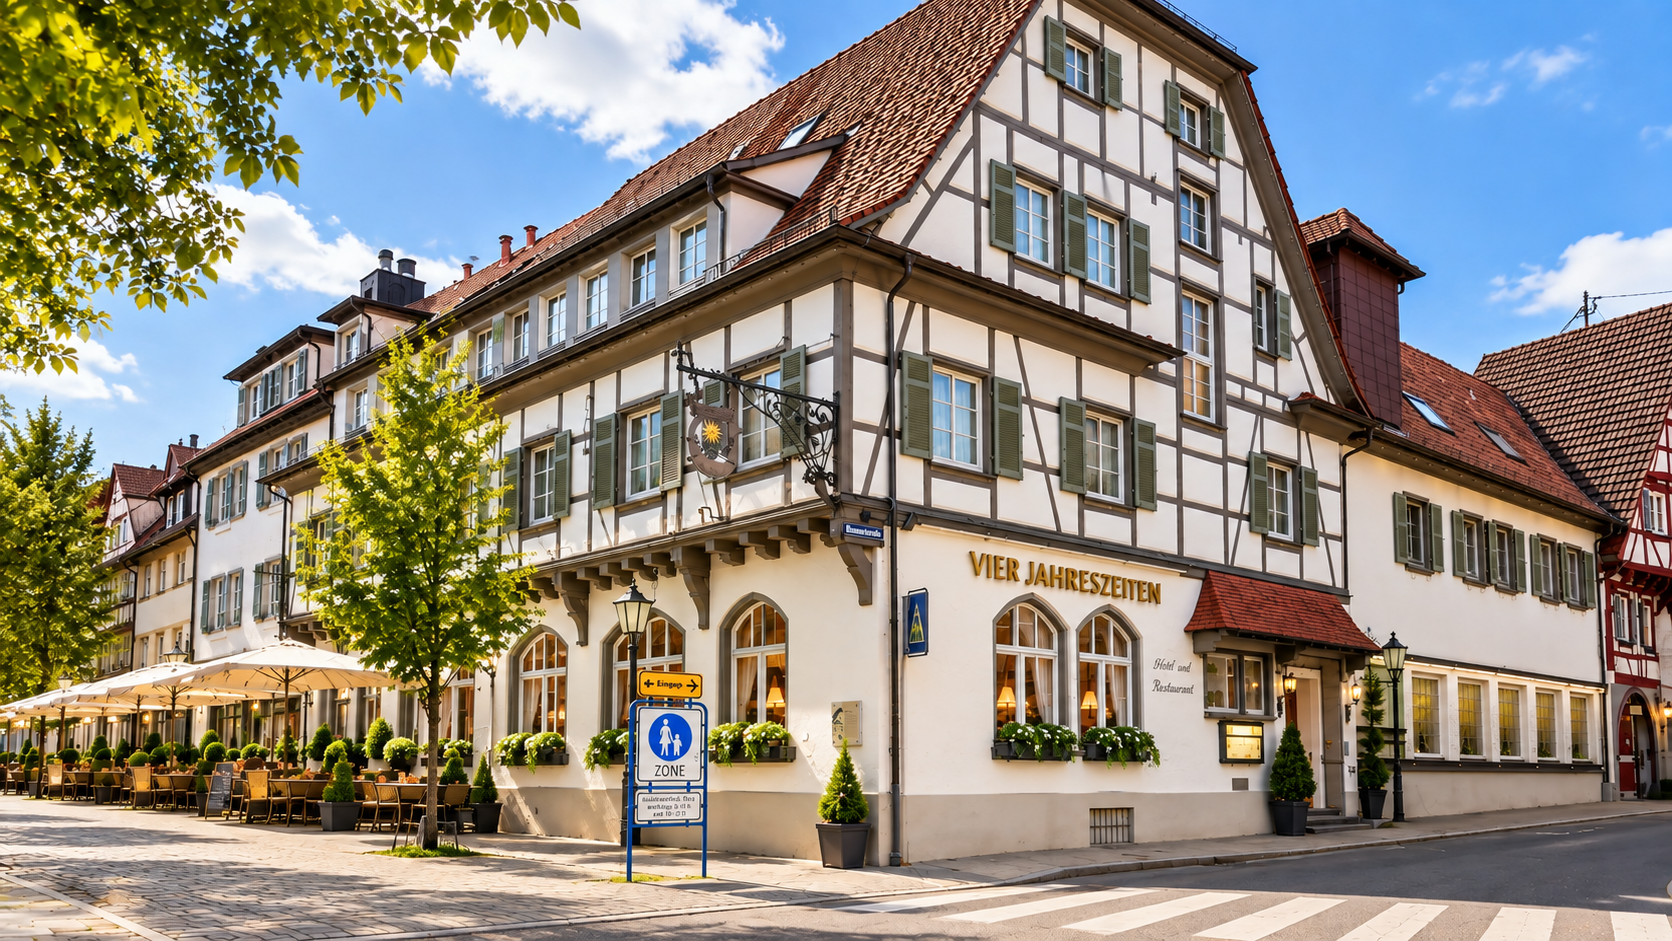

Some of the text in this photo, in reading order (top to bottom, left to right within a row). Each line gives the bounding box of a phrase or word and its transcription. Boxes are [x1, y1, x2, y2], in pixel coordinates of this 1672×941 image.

[969, 551, 1162, 604] VIER JAHRESZEITEN
[654, 764, 686, 777] ZONE
